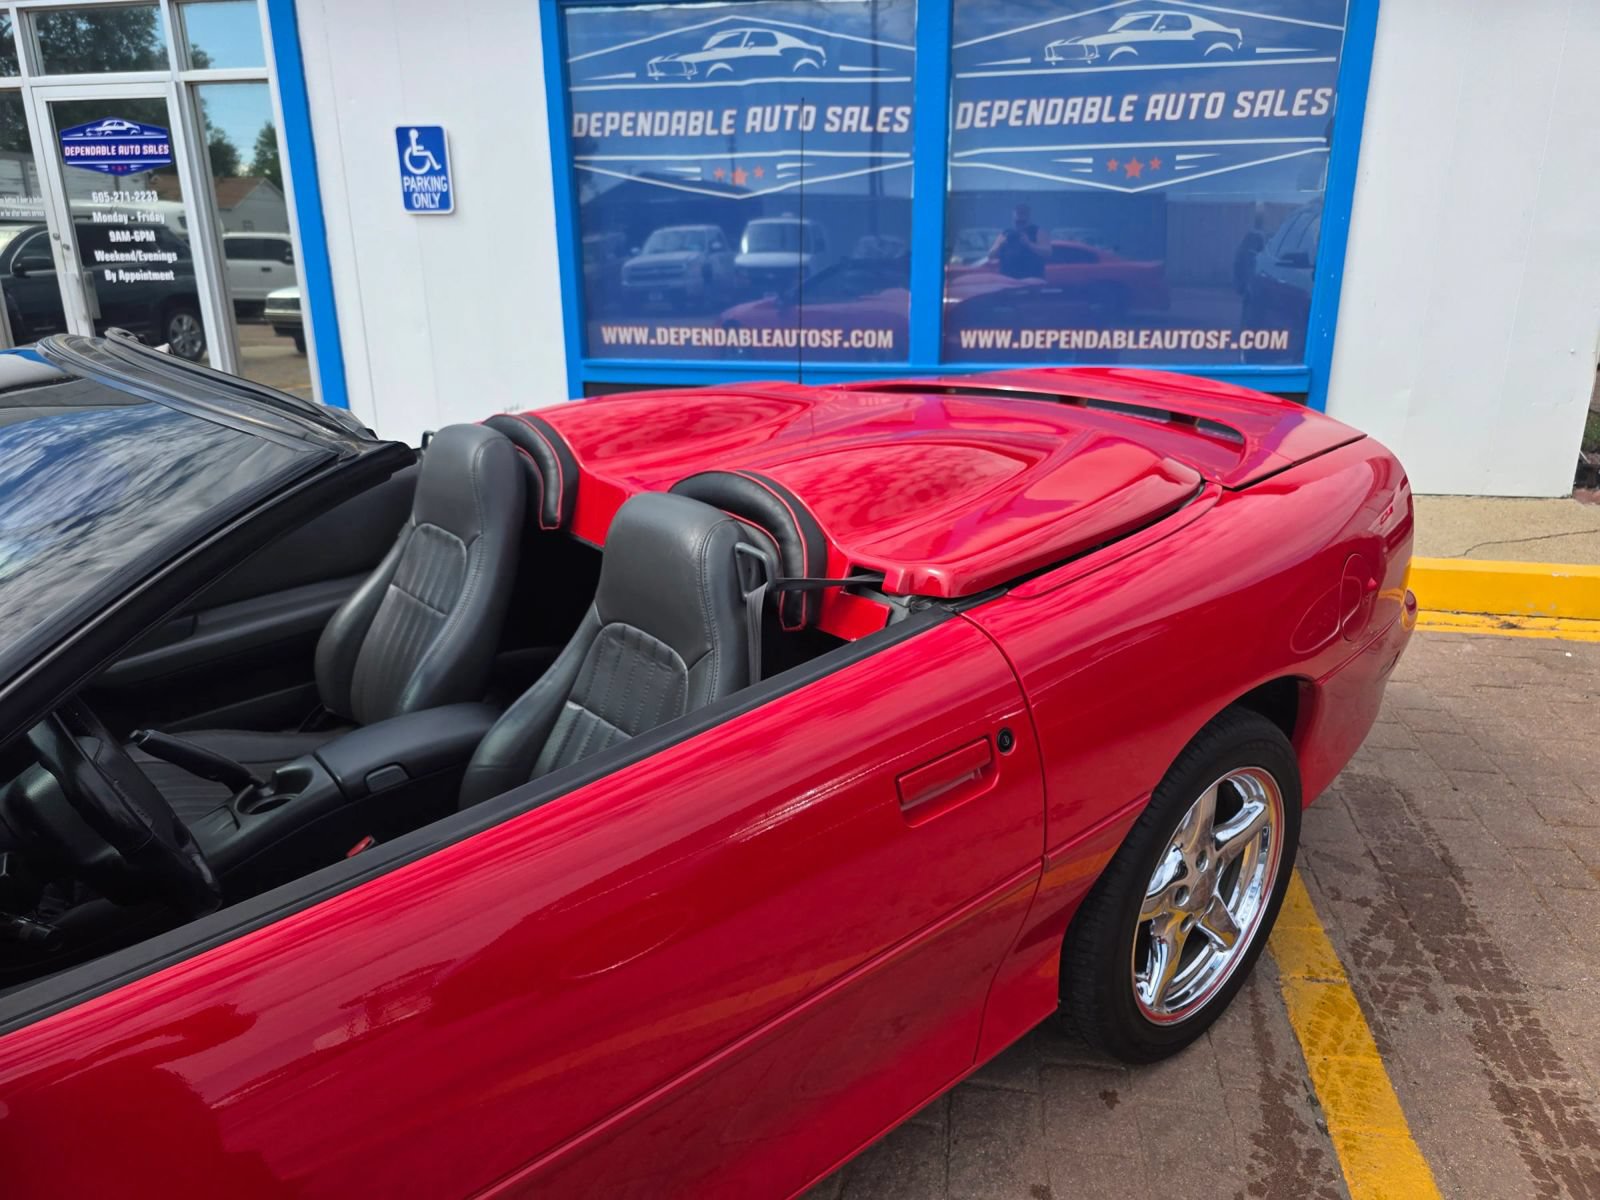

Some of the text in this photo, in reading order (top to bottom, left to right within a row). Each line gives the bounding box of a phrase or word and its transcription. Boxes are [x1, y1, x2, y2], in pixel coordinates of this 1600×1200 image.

[955, 87, 1333, 130] DEPENDABLE AUTO SALES
[572, 104, 912, 137] DEPENDABLE AUTO SALES
[65, 144, 169, 156] DEPENDABLE AUTO SALES
[403, 176, 447, 192] PARKING
[413, 193, 440, 208] ONLY
[92, 212, 128, 224] Monday
[137, 211, 164, 224] Friday
[109, 230, 155, 242] 9AM-6PM
[94, 250, 177, 263] Weekend/Evenings
[104, 269, 175, 283] By Appointment
[601, 325, 894, 349] WWW.DEPENDABLEAUTOSF.COM
[959, 328, 1289, 351] WWW.DEPENDABLEAUTOSF.COM
